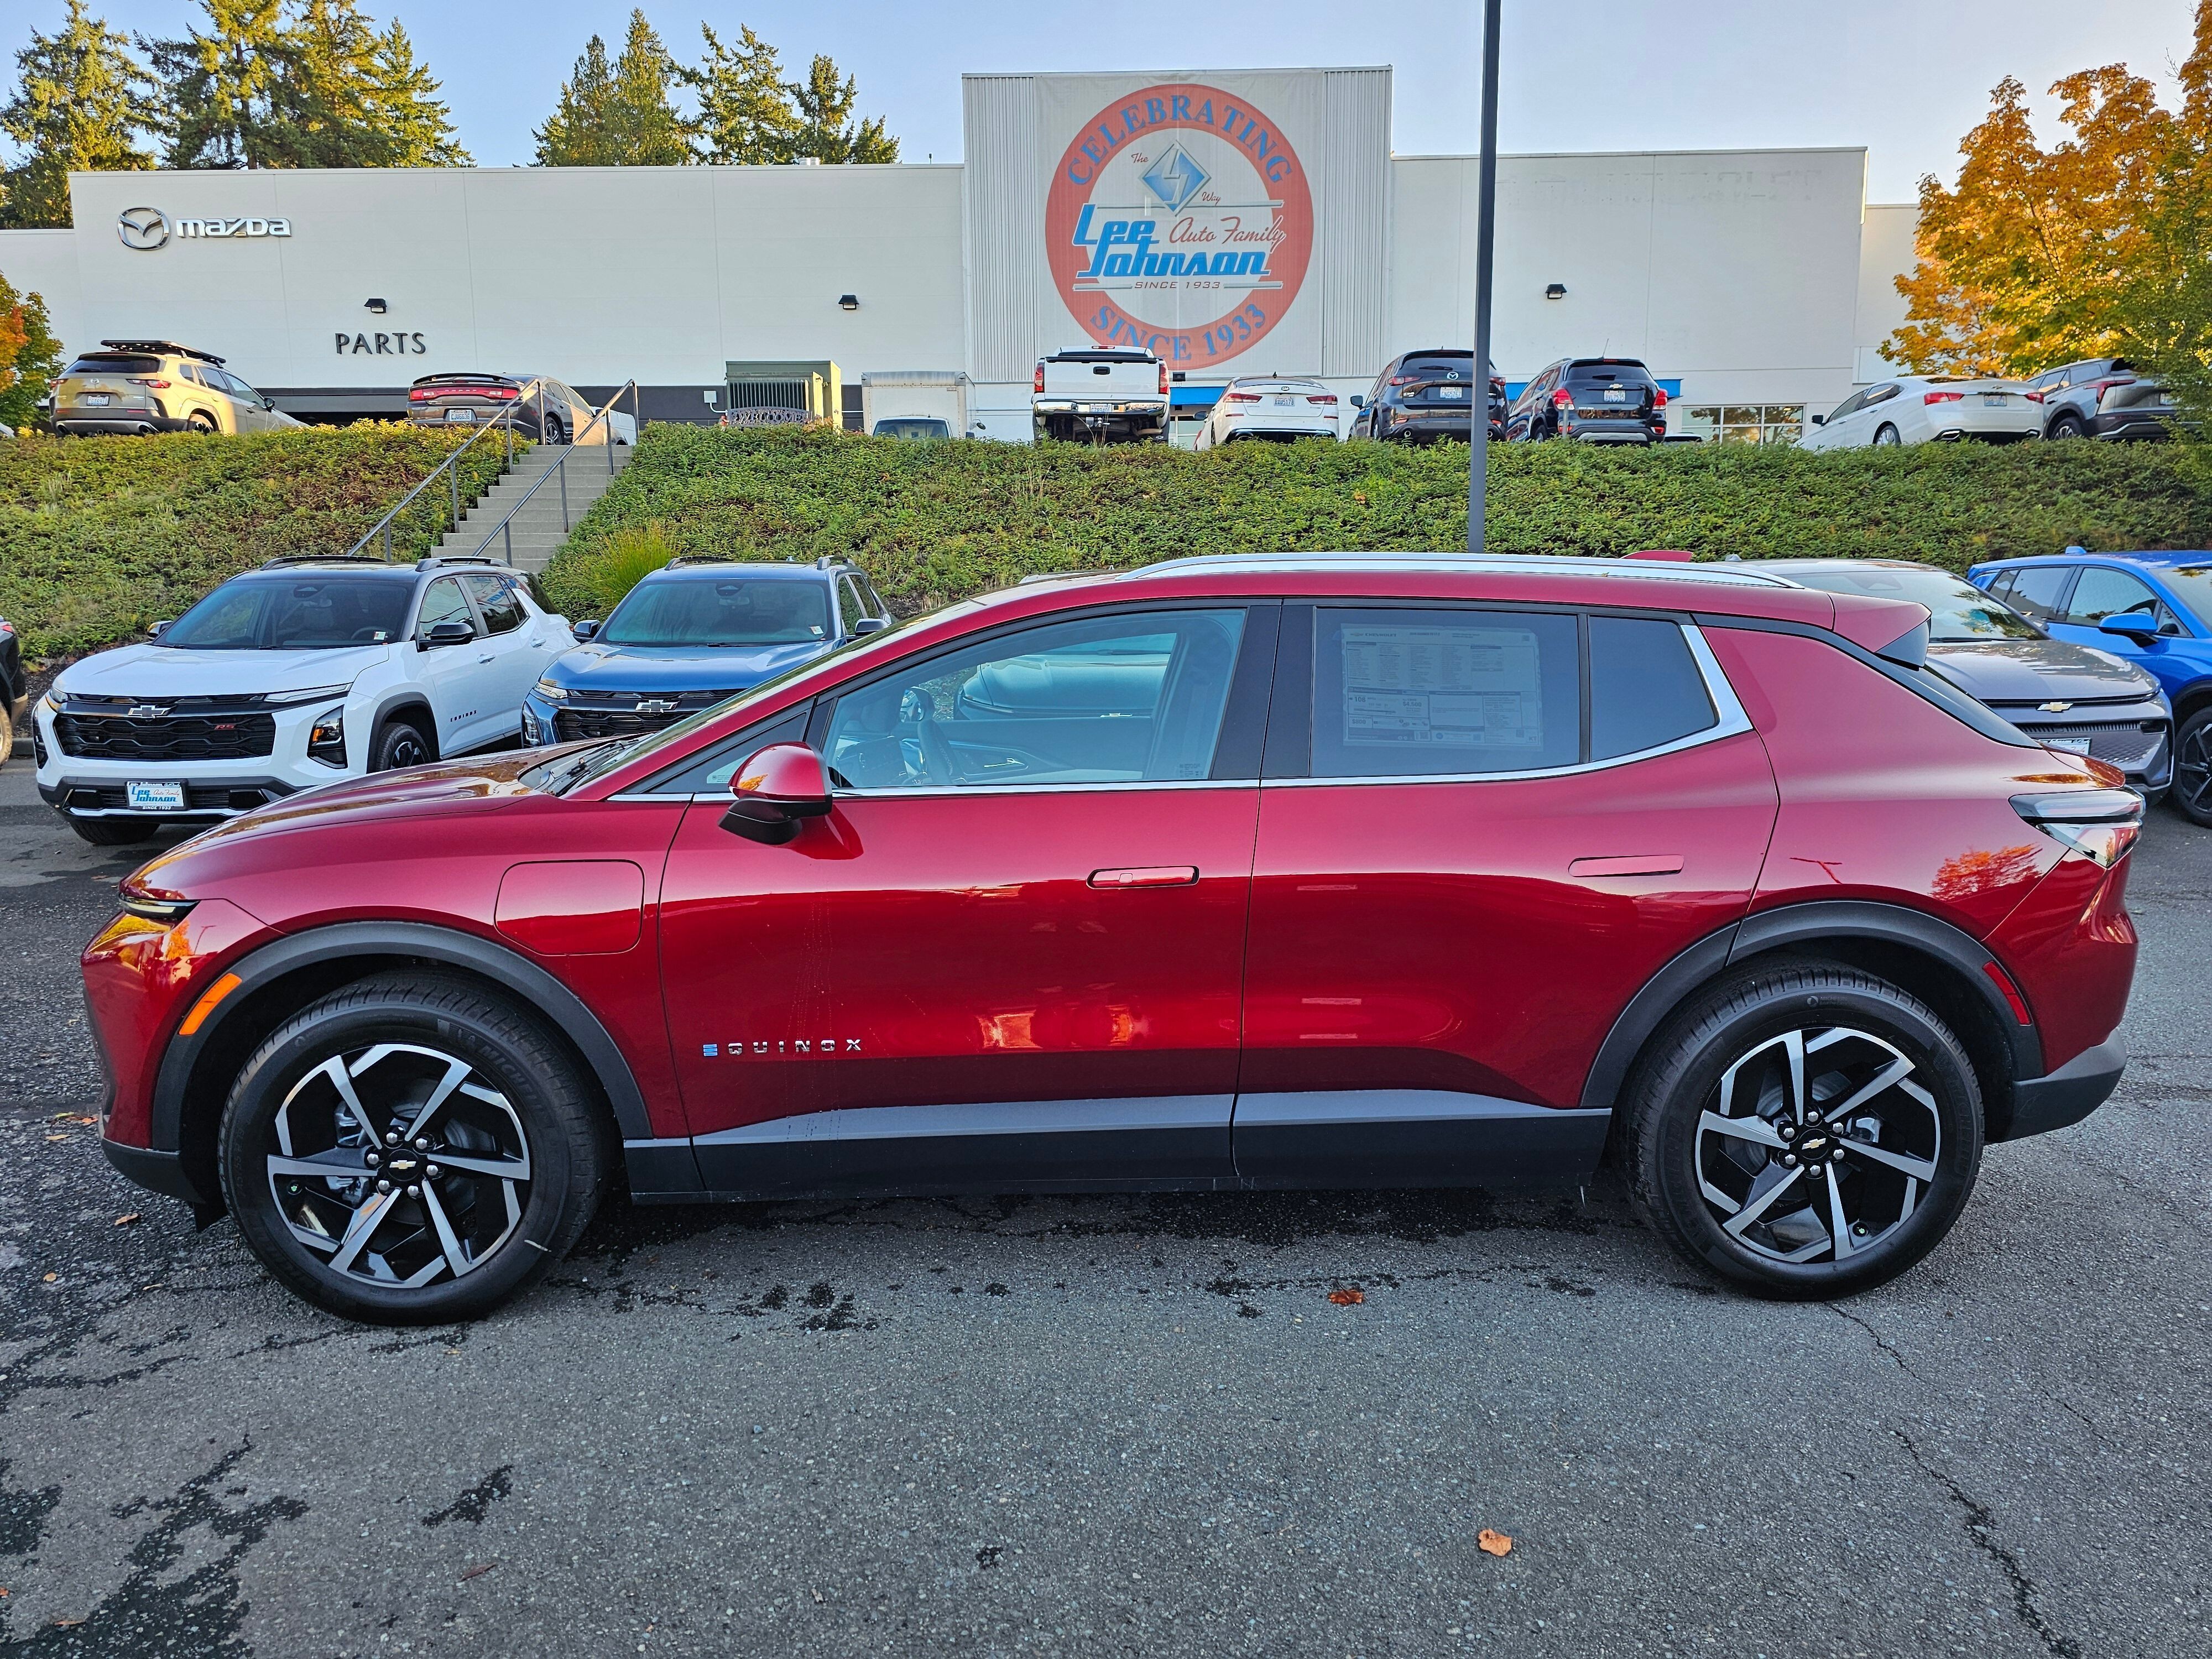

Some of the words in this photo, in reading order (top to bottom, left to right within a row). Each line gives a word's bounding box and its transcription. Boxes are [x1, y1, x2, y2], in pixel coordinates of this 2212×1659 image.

[1068, 94, 1293, 185] CELEBRATING
[1131, 153, 1149, 164] The
[1202, 191, 1221, 205] Way
[176, 218, 291, 237] mazda
[1073, 204, 1159, 245] Lee
[1169, 217, 1217, 244] Auto
[1221, 215, 1286, 252] Family
[1077, 234, 1271, 278] Johnson
[1134, 281, 1178, 289] SINCE
[1185, 281, 1220, 289] 1933
[1090, 305, 1191, 361] SINCE
[1203, 304, 1266, 357] 1933
[335, 332, 426, 354] PARTS
[450, 710, 477, 722] EQUINOX
[132, 786, 150, 795] Lee
[133, 794, 177, 802] Johnson
[165, 789, 180, 797] Family
[703, 1039, 862, 1056] EQUINOX
